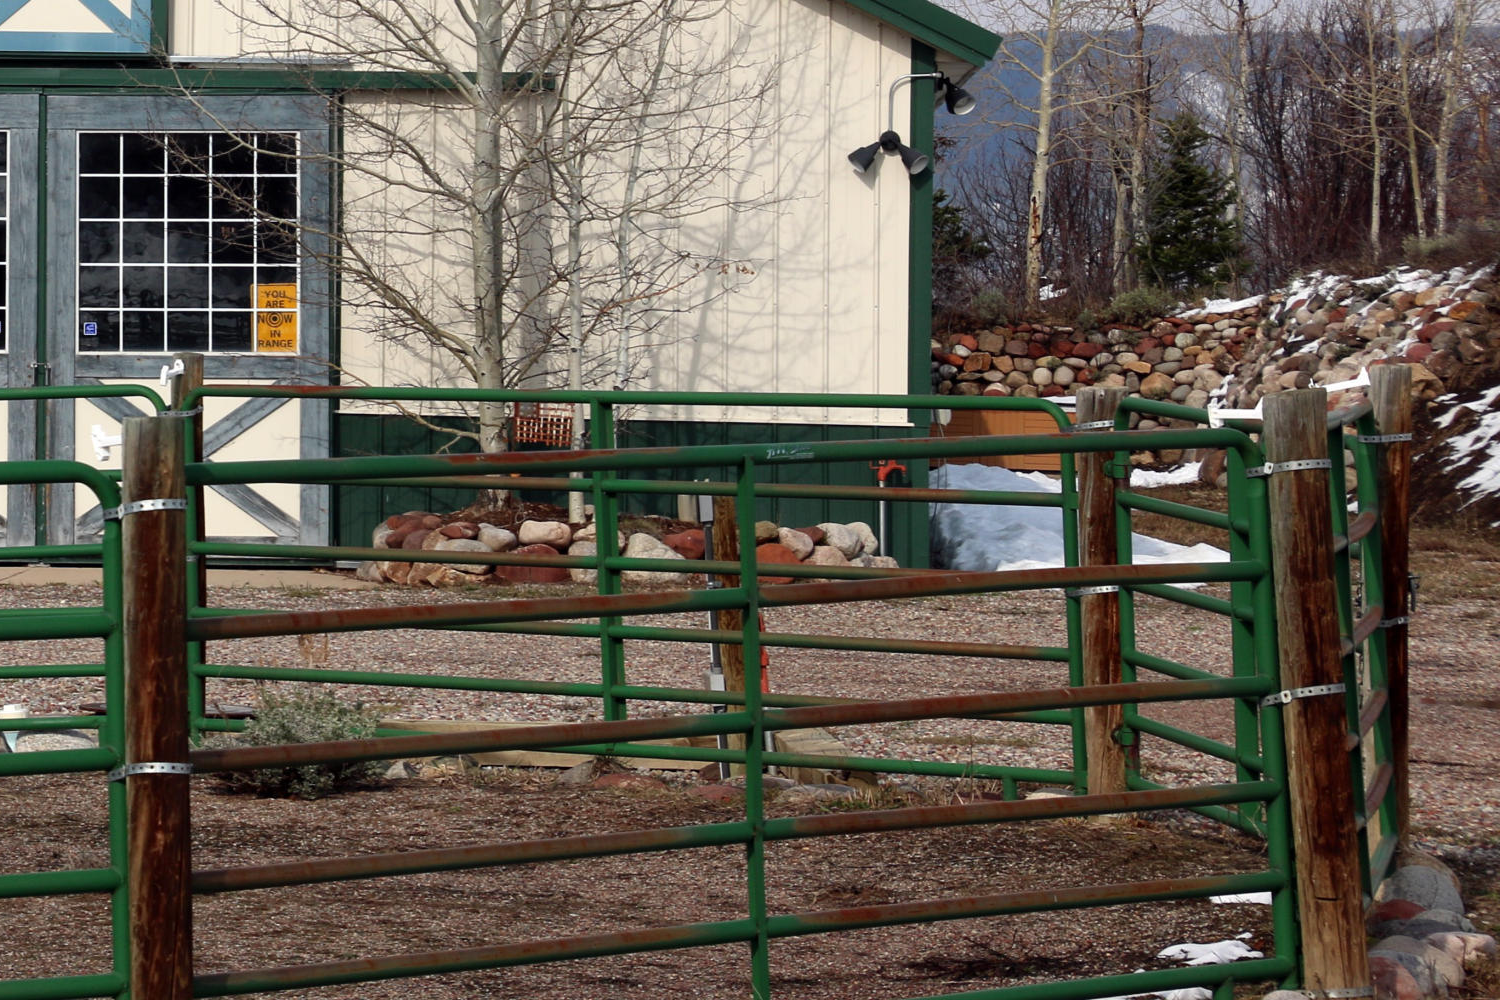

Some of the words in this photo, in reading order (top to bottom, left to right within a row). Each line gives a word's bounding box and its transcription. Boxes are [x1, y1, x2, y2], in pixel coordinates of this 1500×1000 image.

[265, 290, 286, 298] YOU
[265, 300, 285, 308] ARE
[270, 330, 281, 338] IN
[258, 340, 293, 348] RANGE
